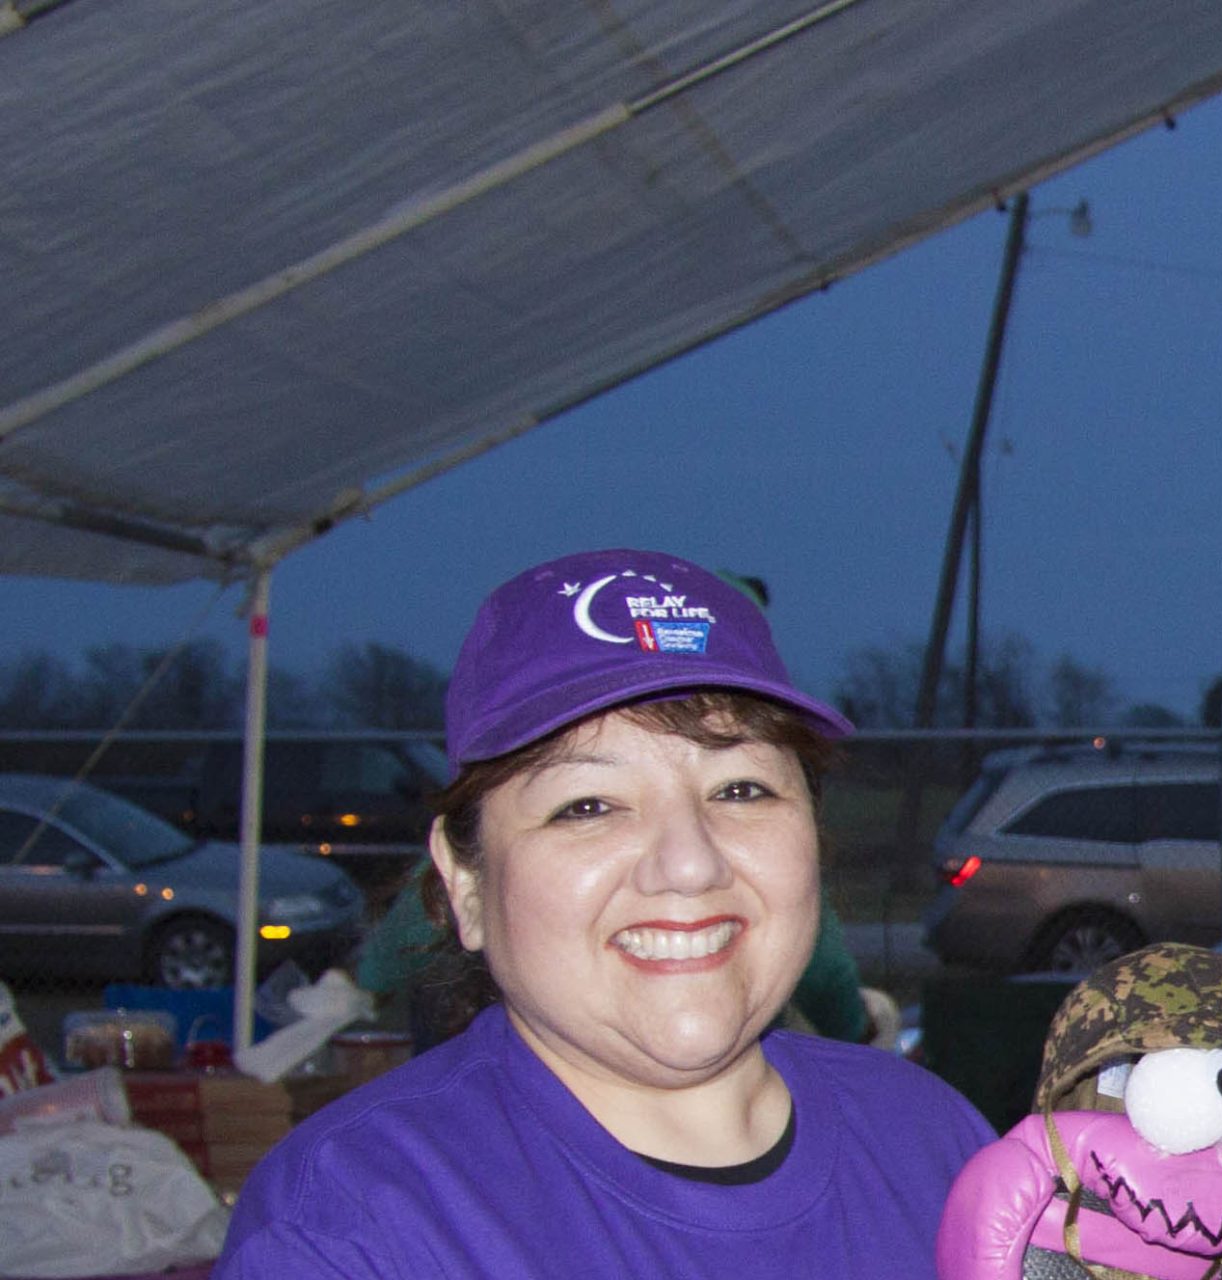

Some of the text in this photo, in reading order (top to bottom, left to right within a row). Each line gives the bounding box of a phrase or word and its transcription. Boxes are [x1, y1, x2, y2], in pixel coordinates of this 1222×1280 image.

[625, 594, 687, 609] RELAY
[630, 606, 709, 618] FOR LIFE
